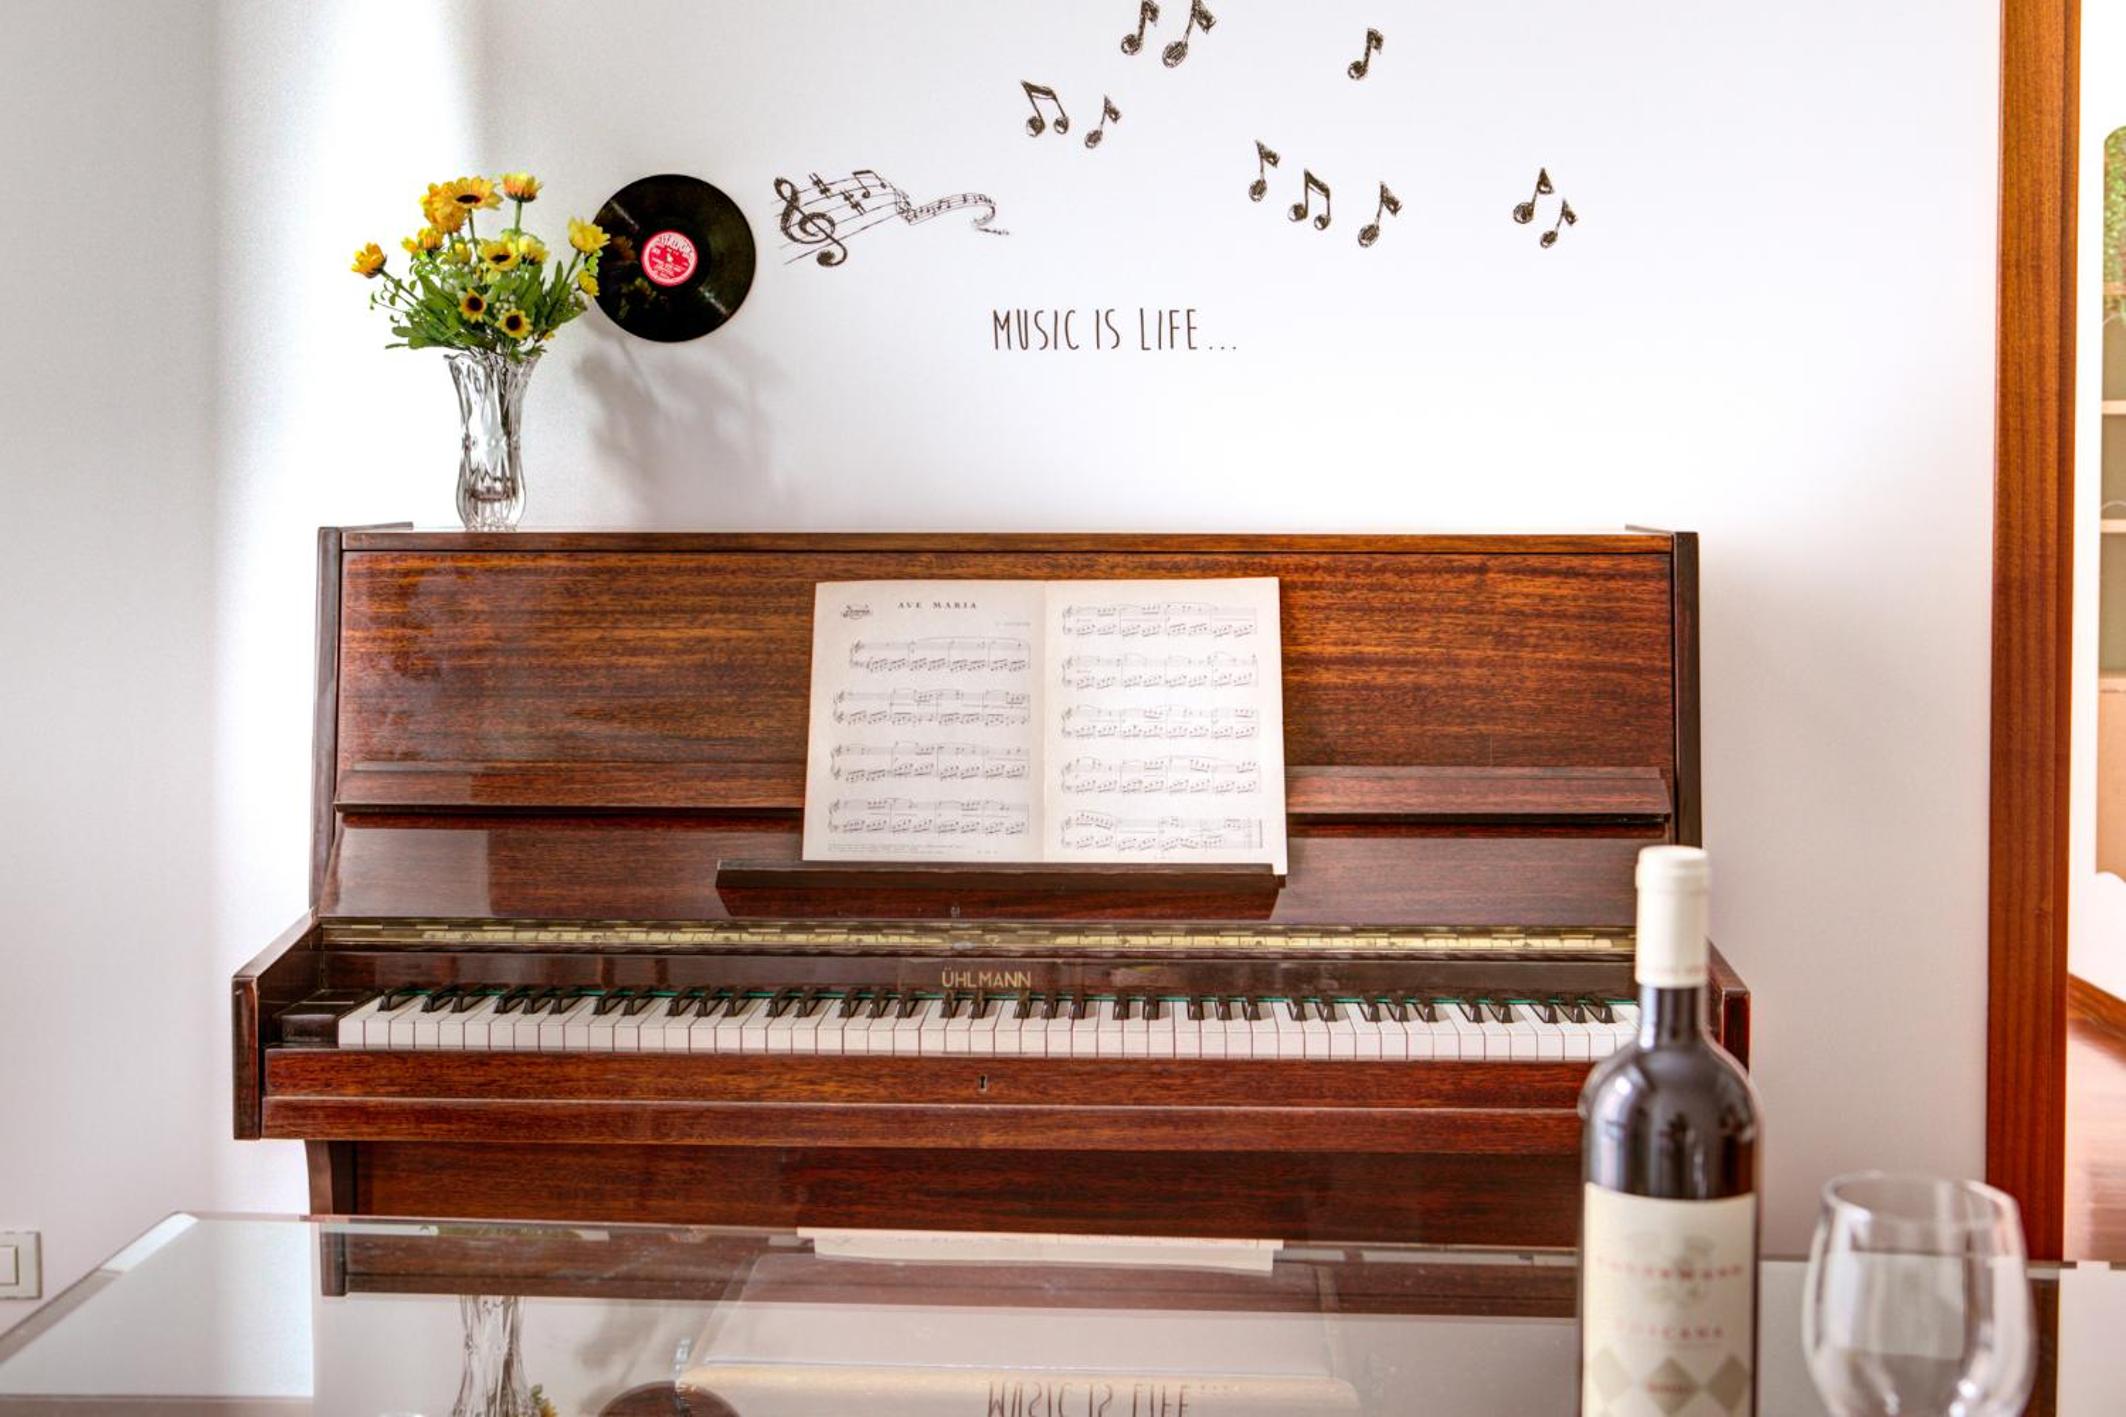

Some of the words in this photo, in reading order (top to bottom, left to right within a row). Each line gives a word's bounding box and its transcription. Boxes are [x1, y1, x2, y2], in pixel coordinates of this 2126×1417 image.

[992, 308, 1080, 351] MUSIC
[1095, 308, 1121, 351] IS
[1139, 307, 1237, 351] LIFE...
[898, 602, 921, 610] AVE
[933, 602, 977, 610] MARIA
